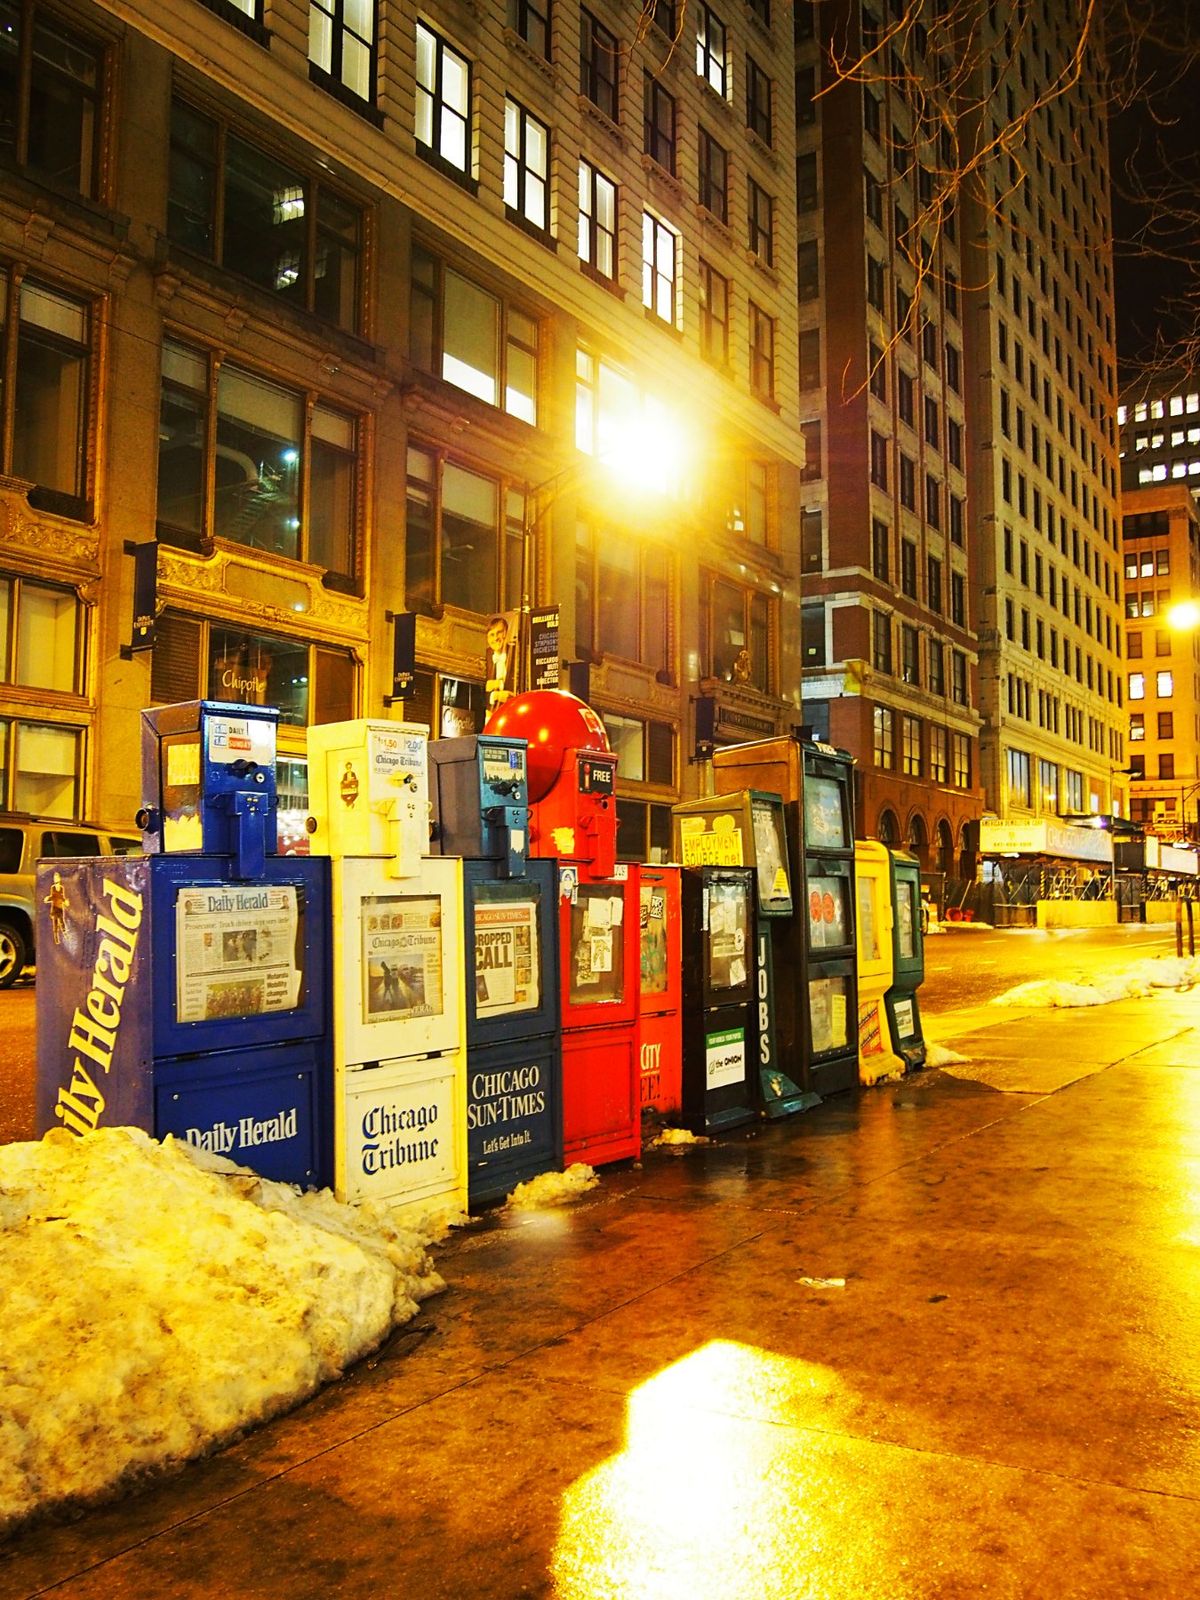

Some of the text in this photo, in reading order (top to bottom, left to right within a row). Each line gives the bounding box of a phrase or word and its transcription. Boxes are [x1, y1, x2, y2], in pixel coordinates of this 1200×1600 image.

[222, 669, 267, 695] Chipotle
[229, 726, 245, 735] DAILY
[375, 755, 422, 766] Chicago Tribune
[592, 769, 611, 783] FREE
[208, 893, 269, 912] Daily Herald
[371, 934, 437, 949] Chicago Tribune
[475, 945, 513, 970] CALL
[54, 878, 144, 1138] ily Herald
[757, 936, 771, 1065] JOBS
[640, 1043, 661, 1070] CITY
[724, 1054, 742, 1066] ONION
[472, 1065, 540, 1100] CHICAGO
[362, 1104, 438, 1139] Chicago
[467, 1091, 546, 1130] SUN-TIMES
[185, 1107, 298, 1153] Daily Herald
[483, 1138, 499, 1154] Let's
[500, 1136, 510, 1150] Get
[510, 1132, 524, 1147] Into
[361, 1137, 439, 1176] Tribune
